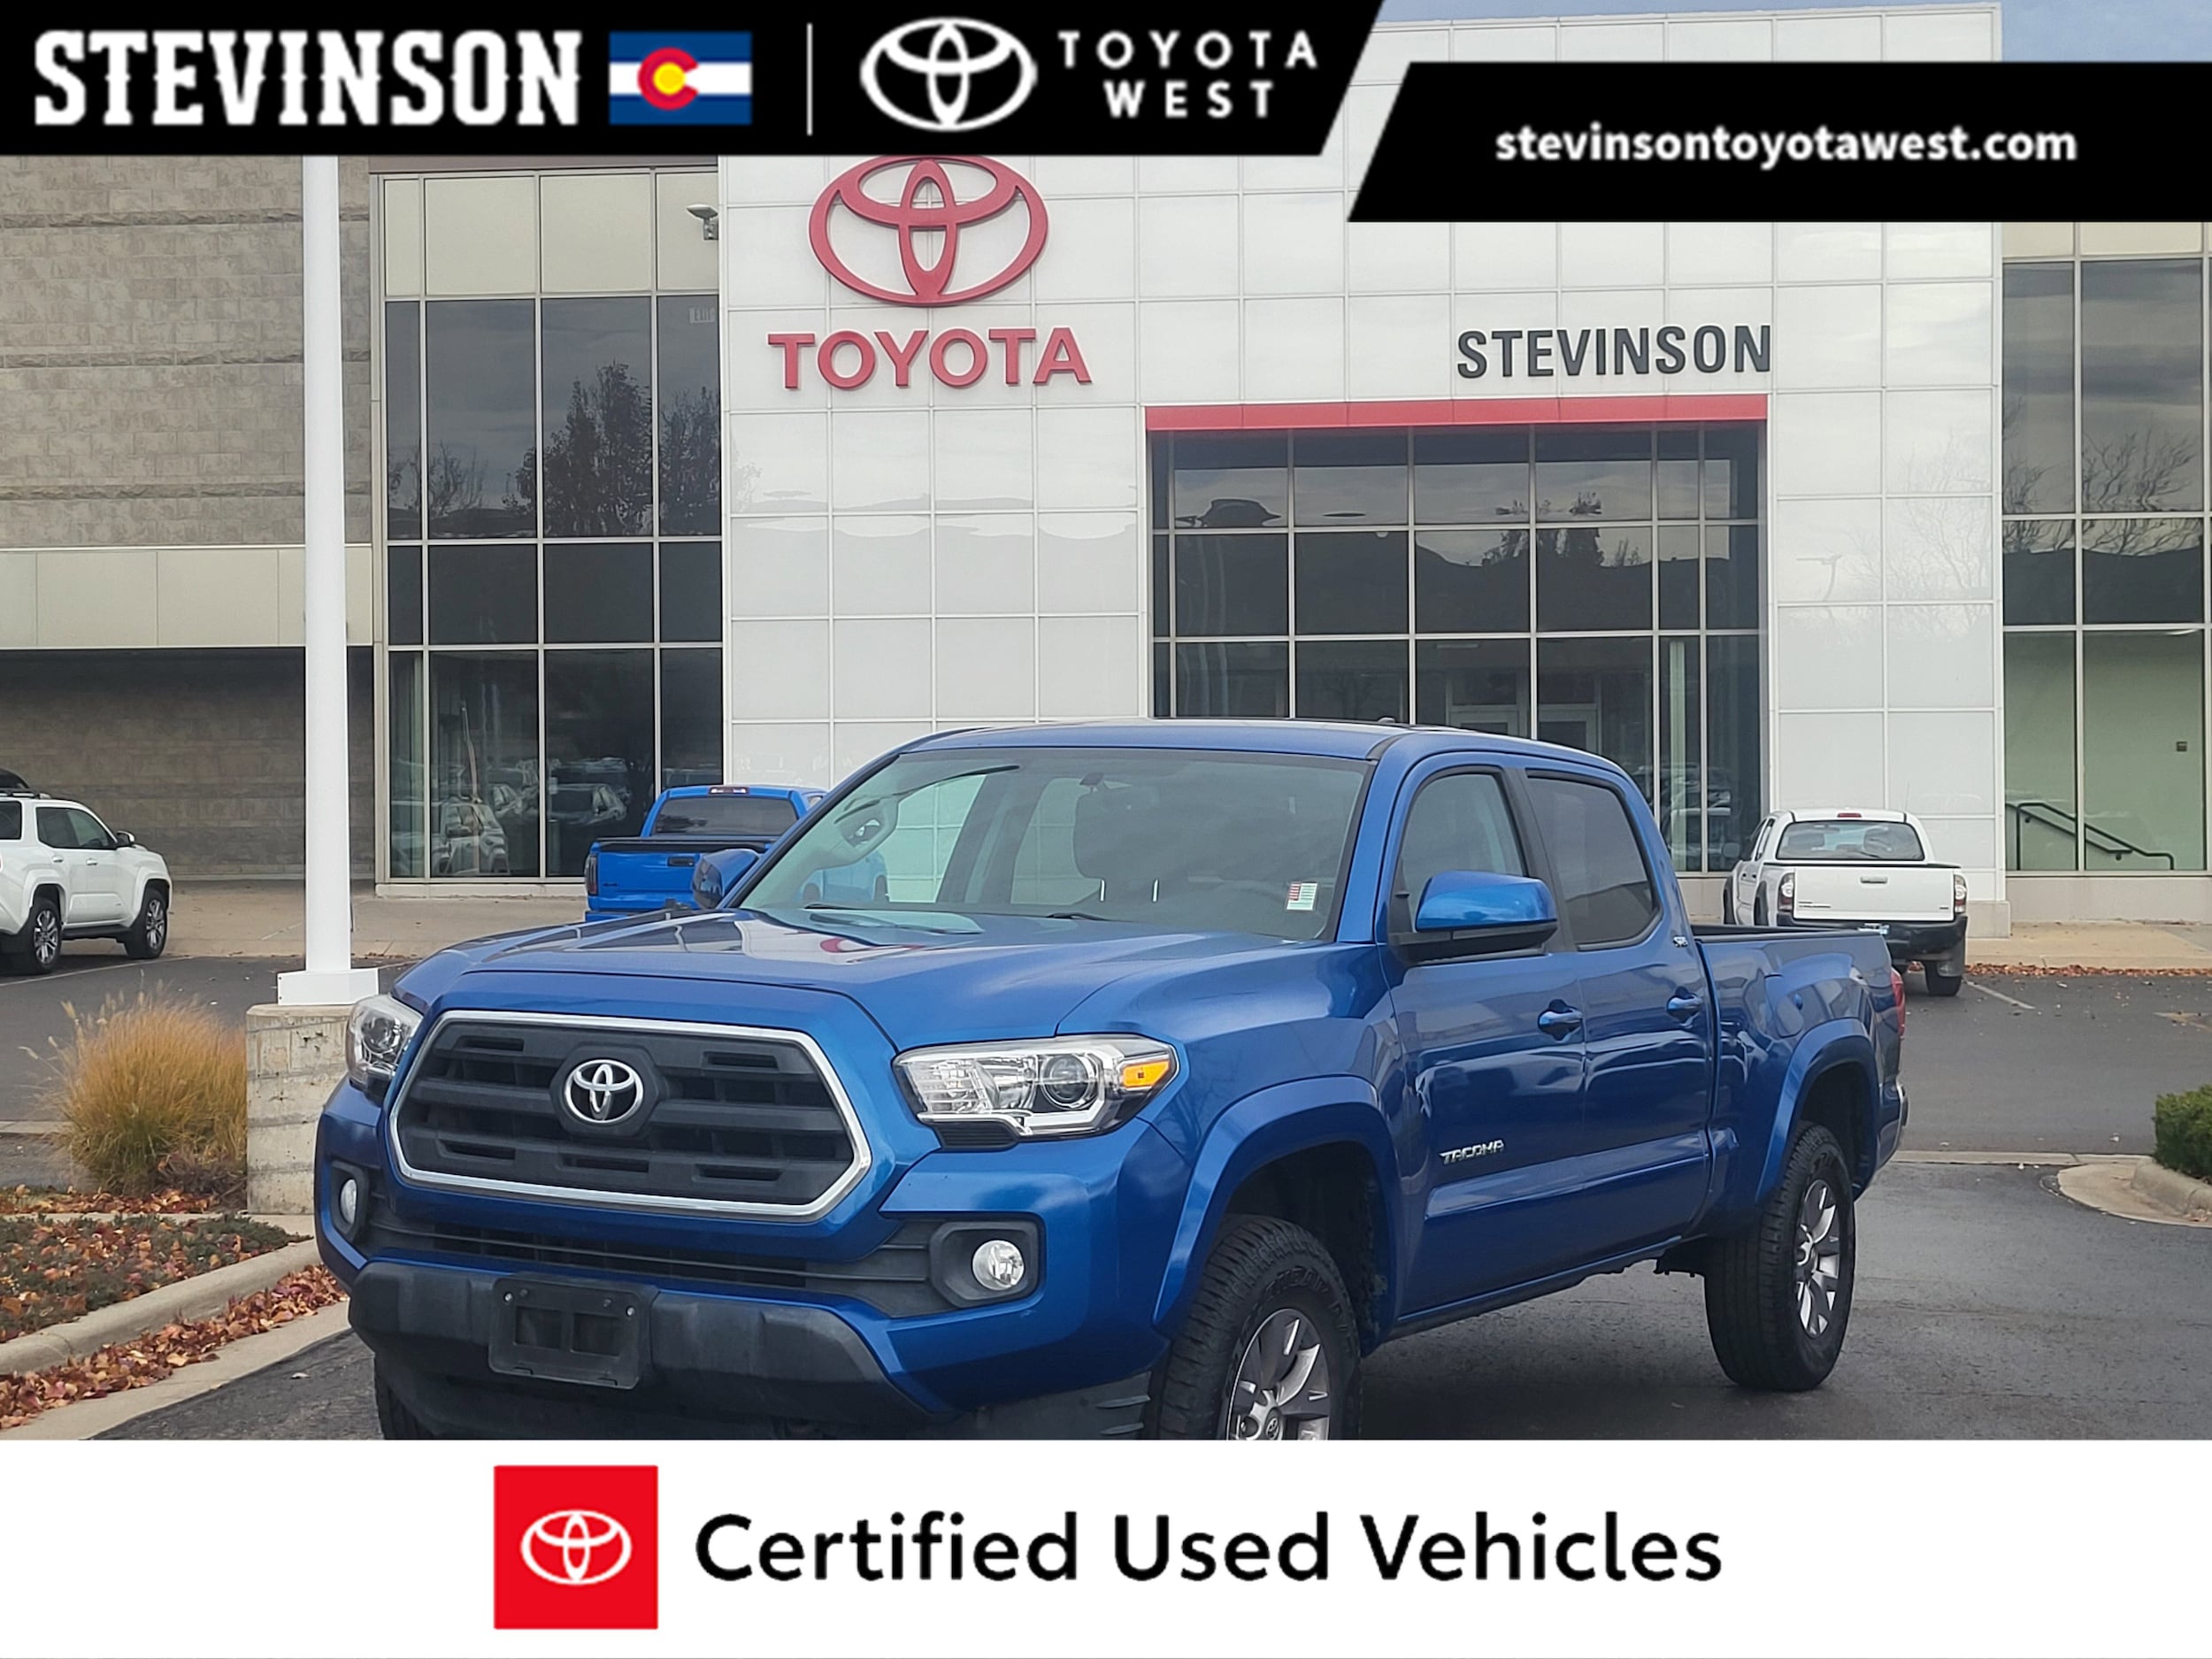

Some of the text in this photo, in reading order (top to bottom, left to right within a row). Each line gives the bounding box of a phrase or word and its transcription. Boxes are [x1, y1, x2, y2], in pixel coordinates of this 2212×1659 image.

[767, 327, 1091, 389] TOYOTA
[1457, 325, 1770, 379] STEVINSON
[1440, 1139, 1504, 1164] TACOMA
